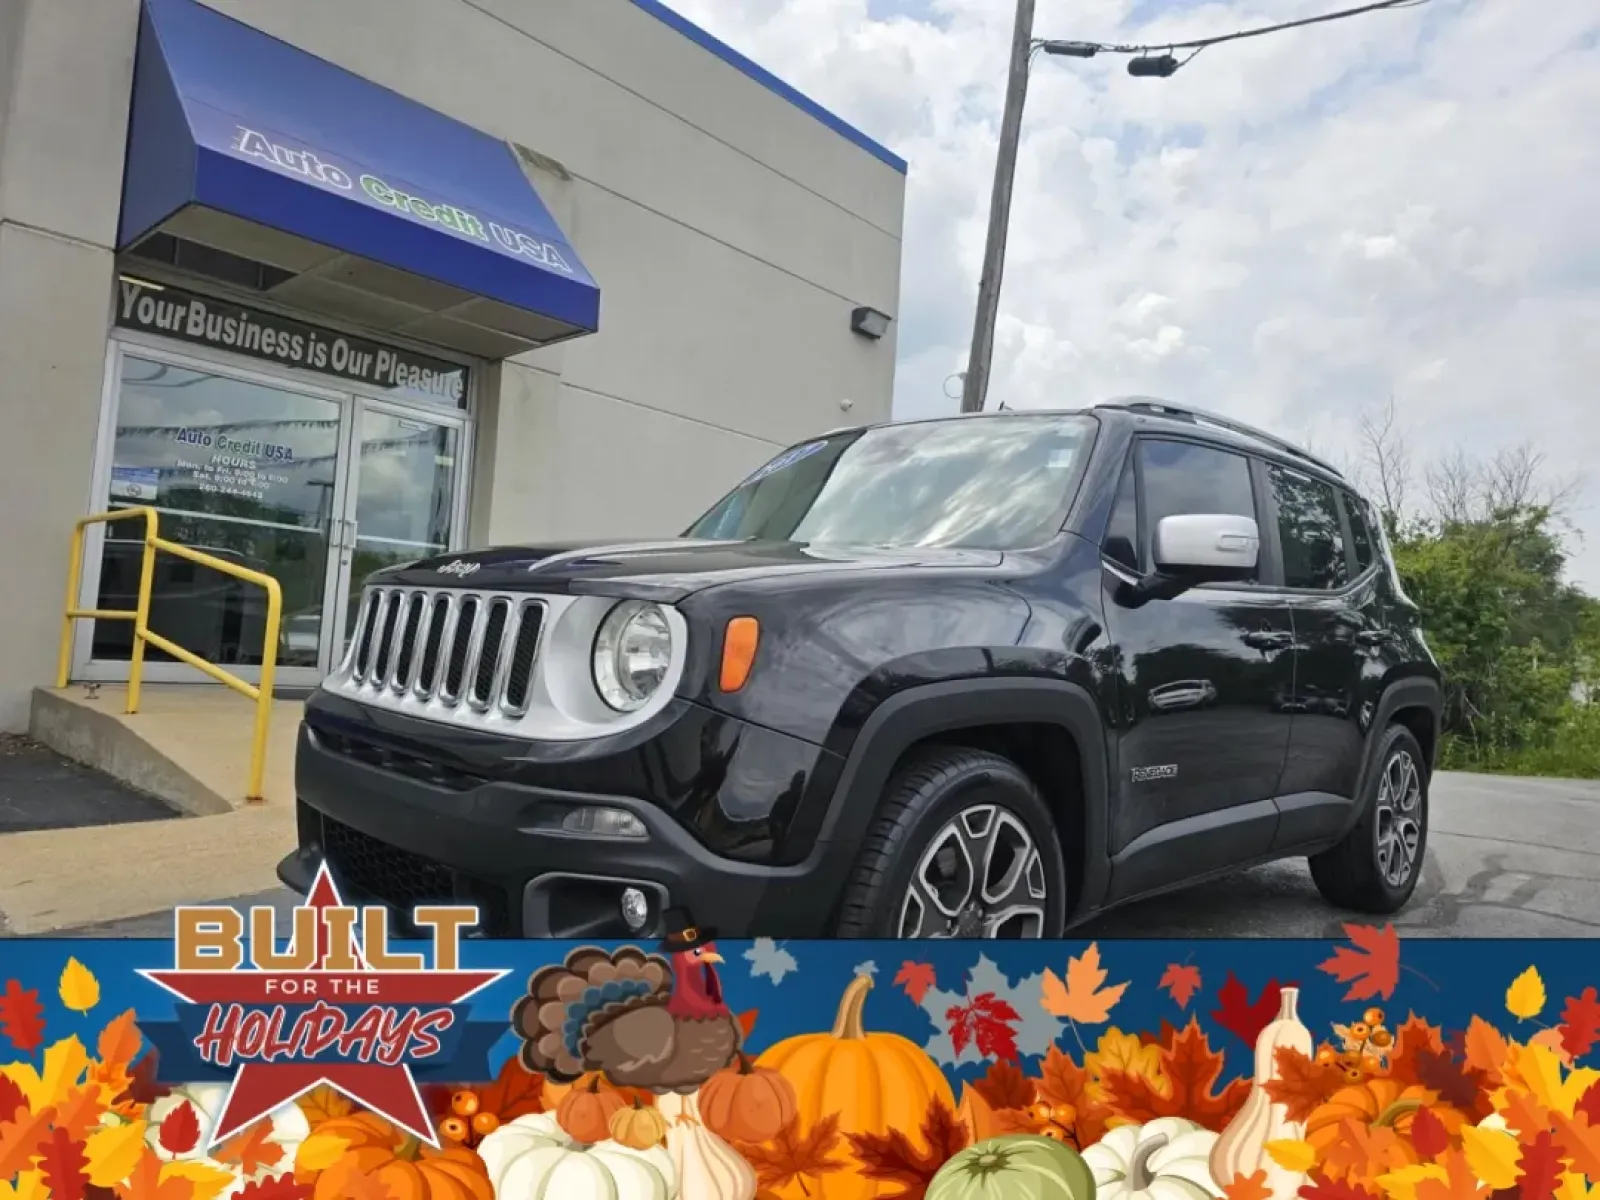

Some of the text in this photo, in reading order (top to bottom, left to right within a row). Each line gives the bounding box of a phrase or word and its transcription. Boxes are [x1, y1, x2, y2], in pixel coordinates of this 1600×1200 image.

[232, 125, 573, 273] Auto Credit USA
[307, 332, 327, 367] is
[331, 338, 373, 377] Our
[374, 349, 463, 399] Pleasure
[177, 427, 293, 462] Auto Credit USA
[211, 454, 256, 470] HOURS
